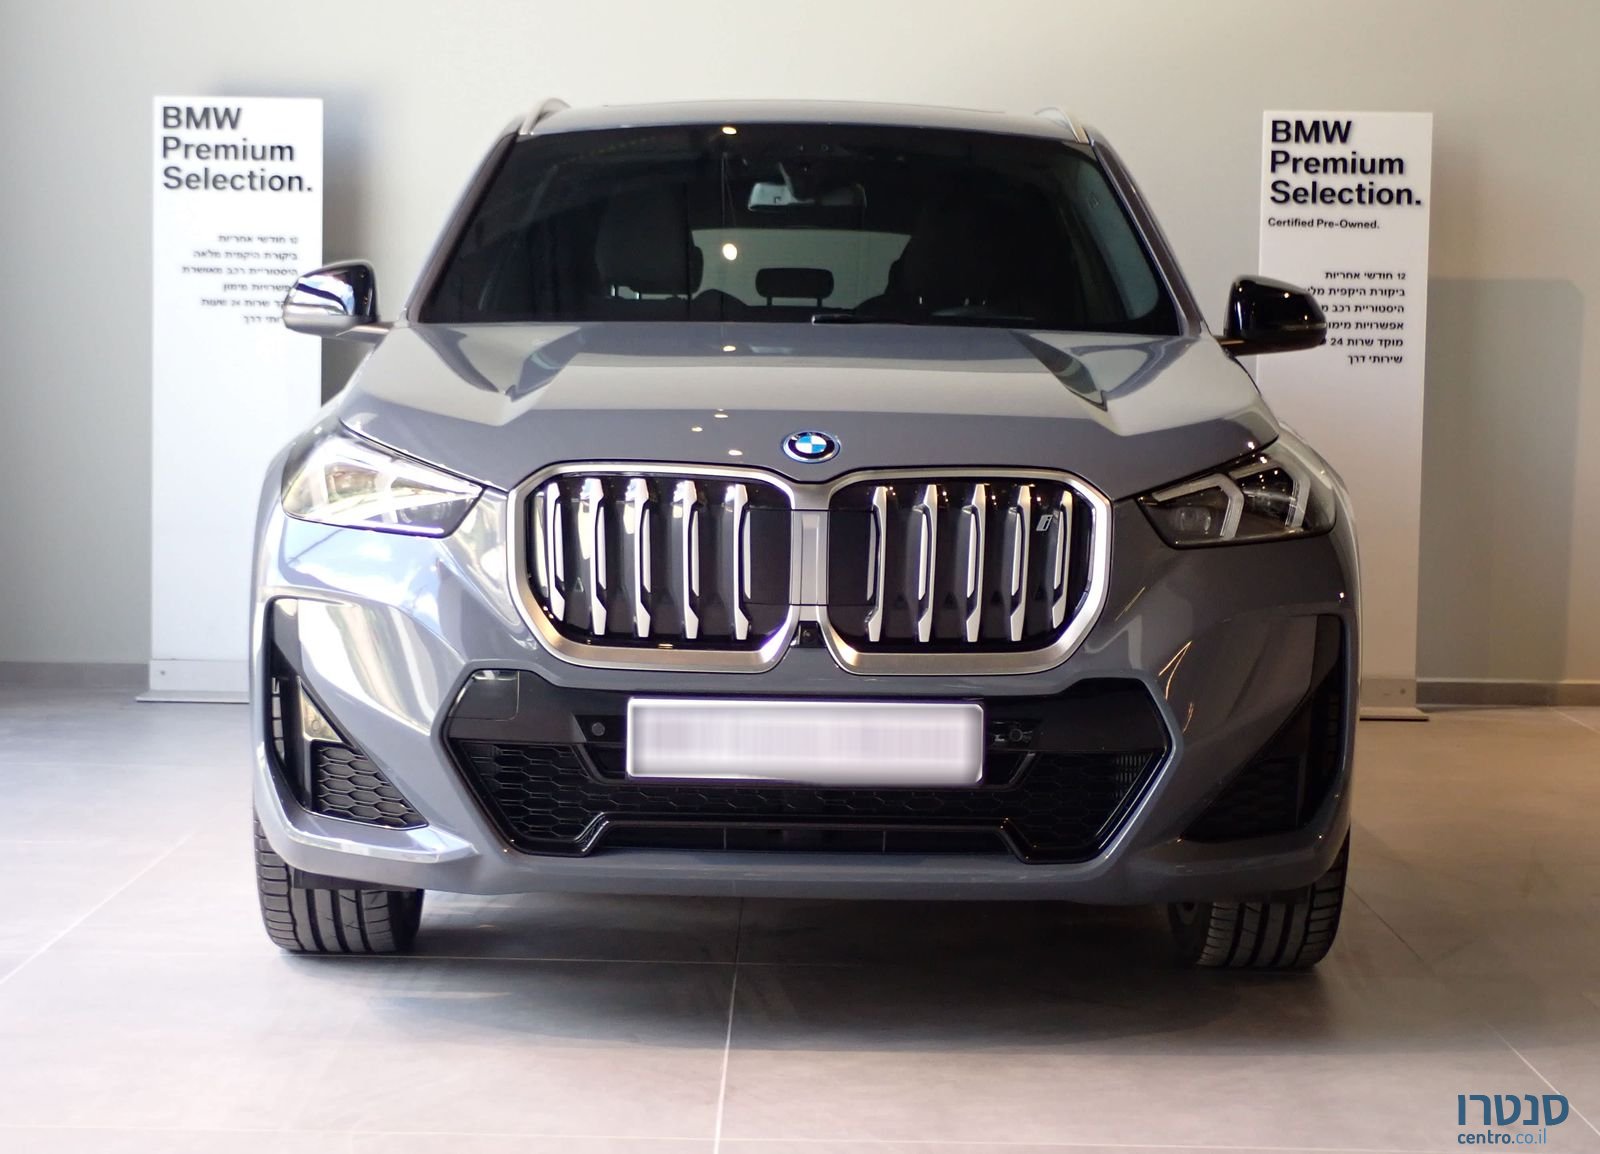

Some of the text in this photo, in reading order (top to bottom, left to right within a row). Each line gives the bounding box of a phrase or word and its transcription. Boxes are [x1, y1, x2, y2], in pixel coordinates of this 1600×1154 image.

[162, 106, 241, 130] BMW
[1271, 120, 1352, 144] BMW
[162, 137, 294, 161] Premium
[1270, 150, 1404, 174] Premium
[163, 166, 312, 192] Selection.
[1270, 180, 1421, 205] Selection.
[1268, 218, 1380, 229] Certified Pre-Owned.
[1329, 288, 1366, 297] היקפית
[1370, 288, 1405, 298] ביקורת
[1347, 338, 1373, 346] שרות
[1378, 338, 1403, 348] מוקד
[1348, 356, 1365, 365] דרך
